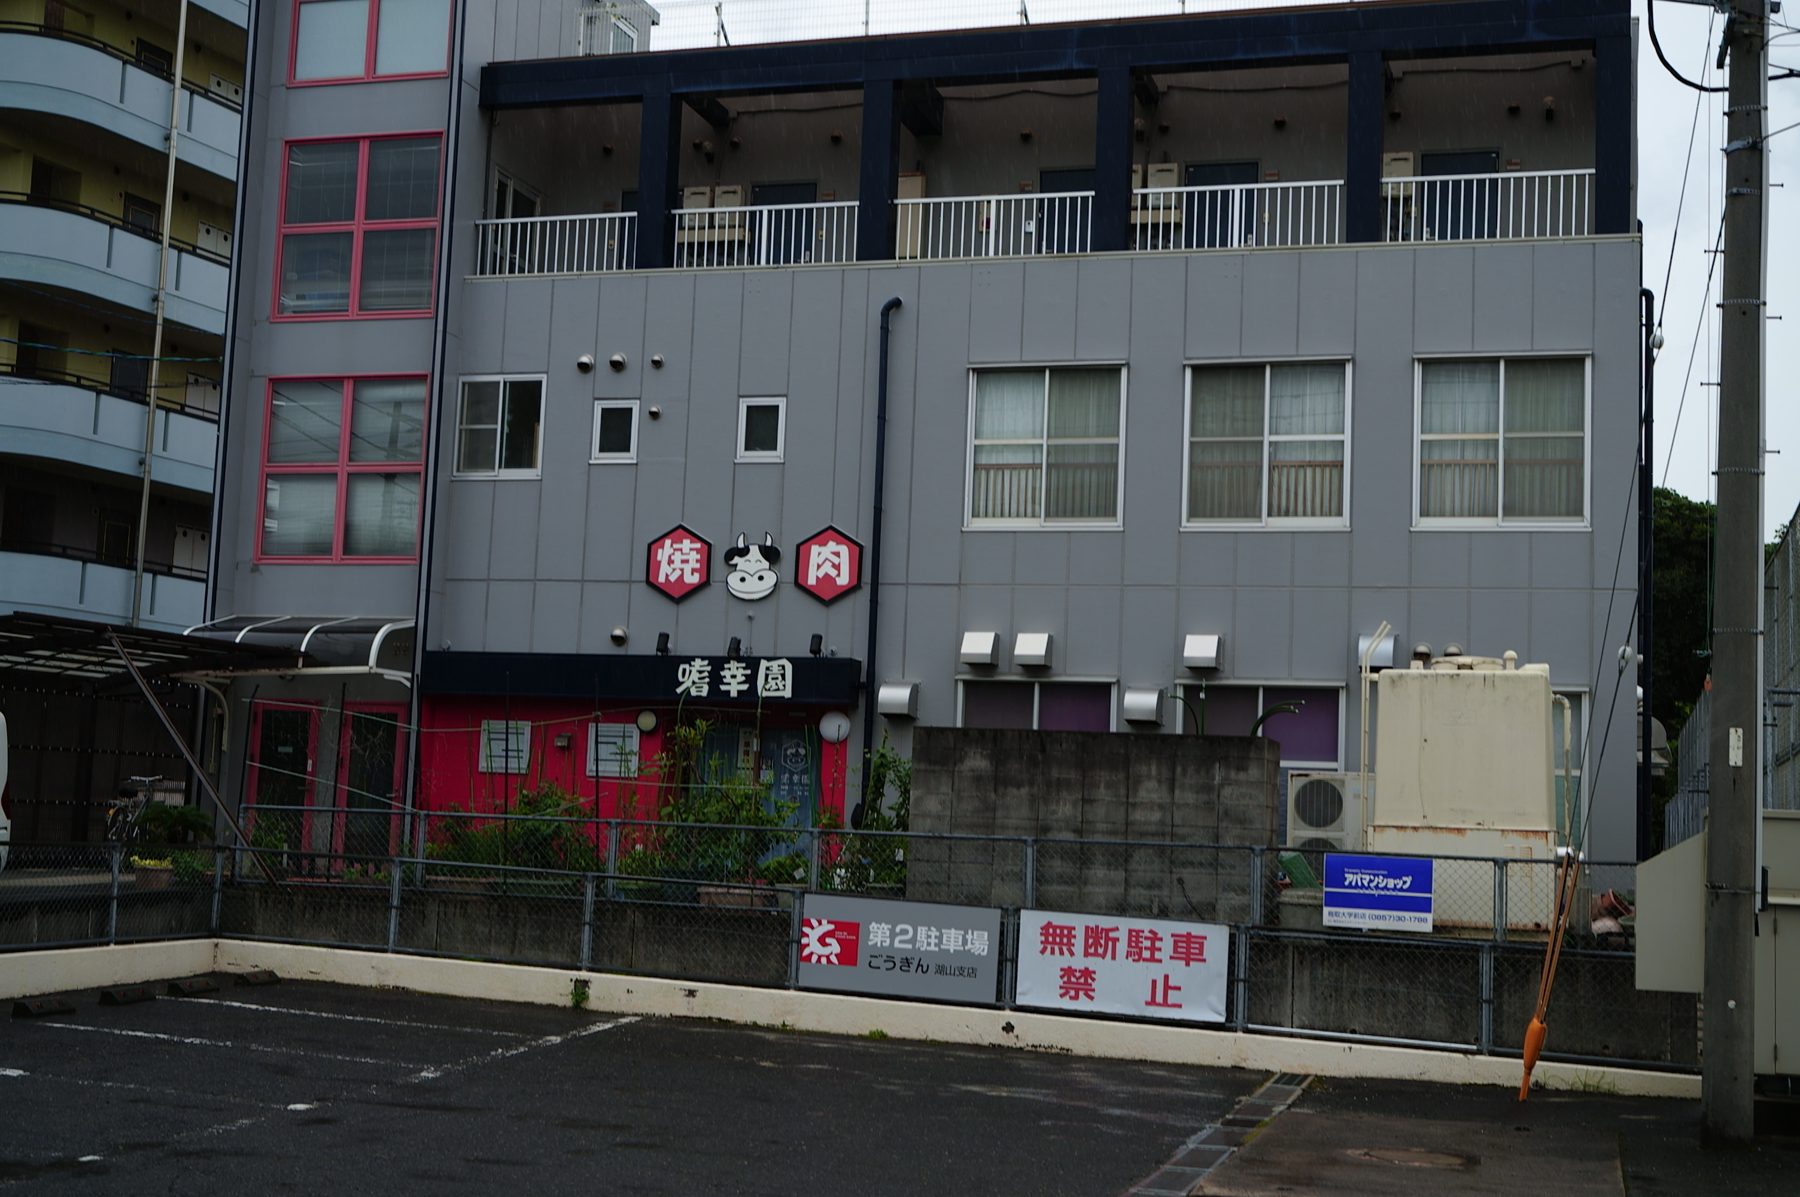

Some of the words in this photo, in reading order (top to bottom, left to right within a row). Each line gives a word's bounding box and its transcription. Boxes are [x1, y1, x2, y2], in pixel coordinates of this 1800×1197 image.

[657, 538, 701, 584] 焼
[807, 540, 851, 586] 肉
[675, 657, 793, 699] 嗜幸園
[1344, 873, 1413, 890] アパマンショップ
[867, 921, 990, 957] 第2駐車場
[1038, 920, 1208, 967] 無断駐車
[868, 954, 930, 975] ごうぎん
[934, 963, 978, 979] 湖山支店
